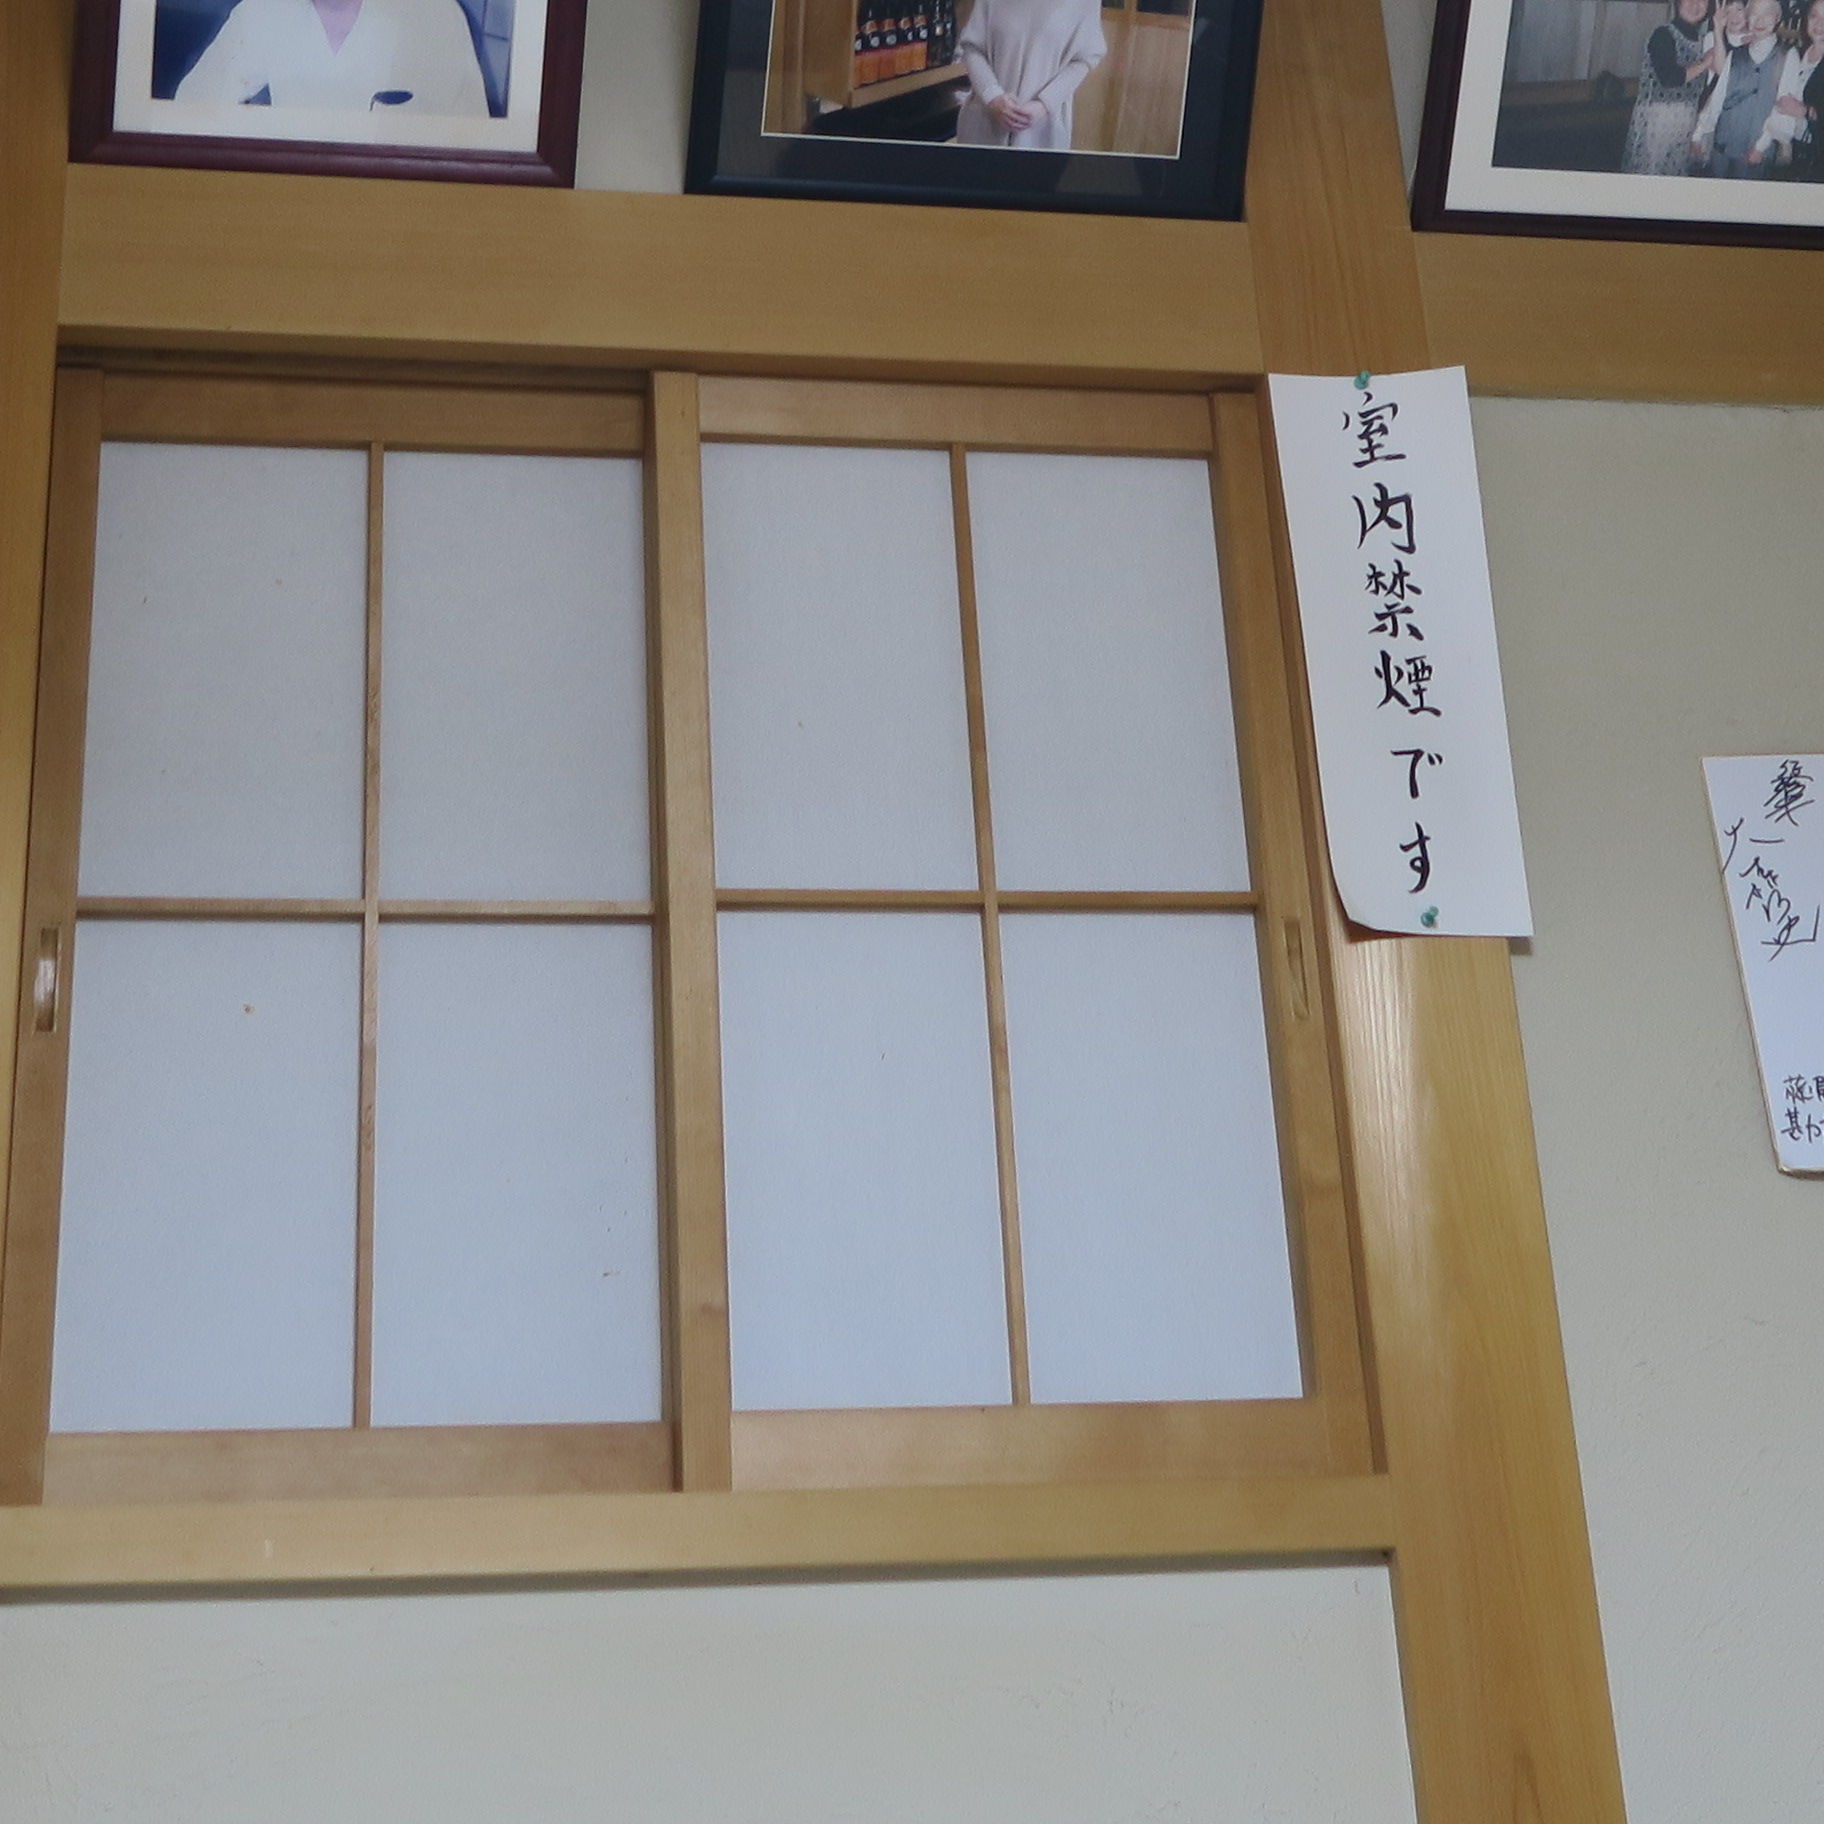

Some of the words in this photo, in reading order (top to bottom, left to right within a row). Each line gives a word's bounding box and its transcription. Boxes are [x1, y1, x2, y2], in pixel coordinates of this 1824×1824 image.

[1341, 390, 1444, 895] 室内禁煙です
